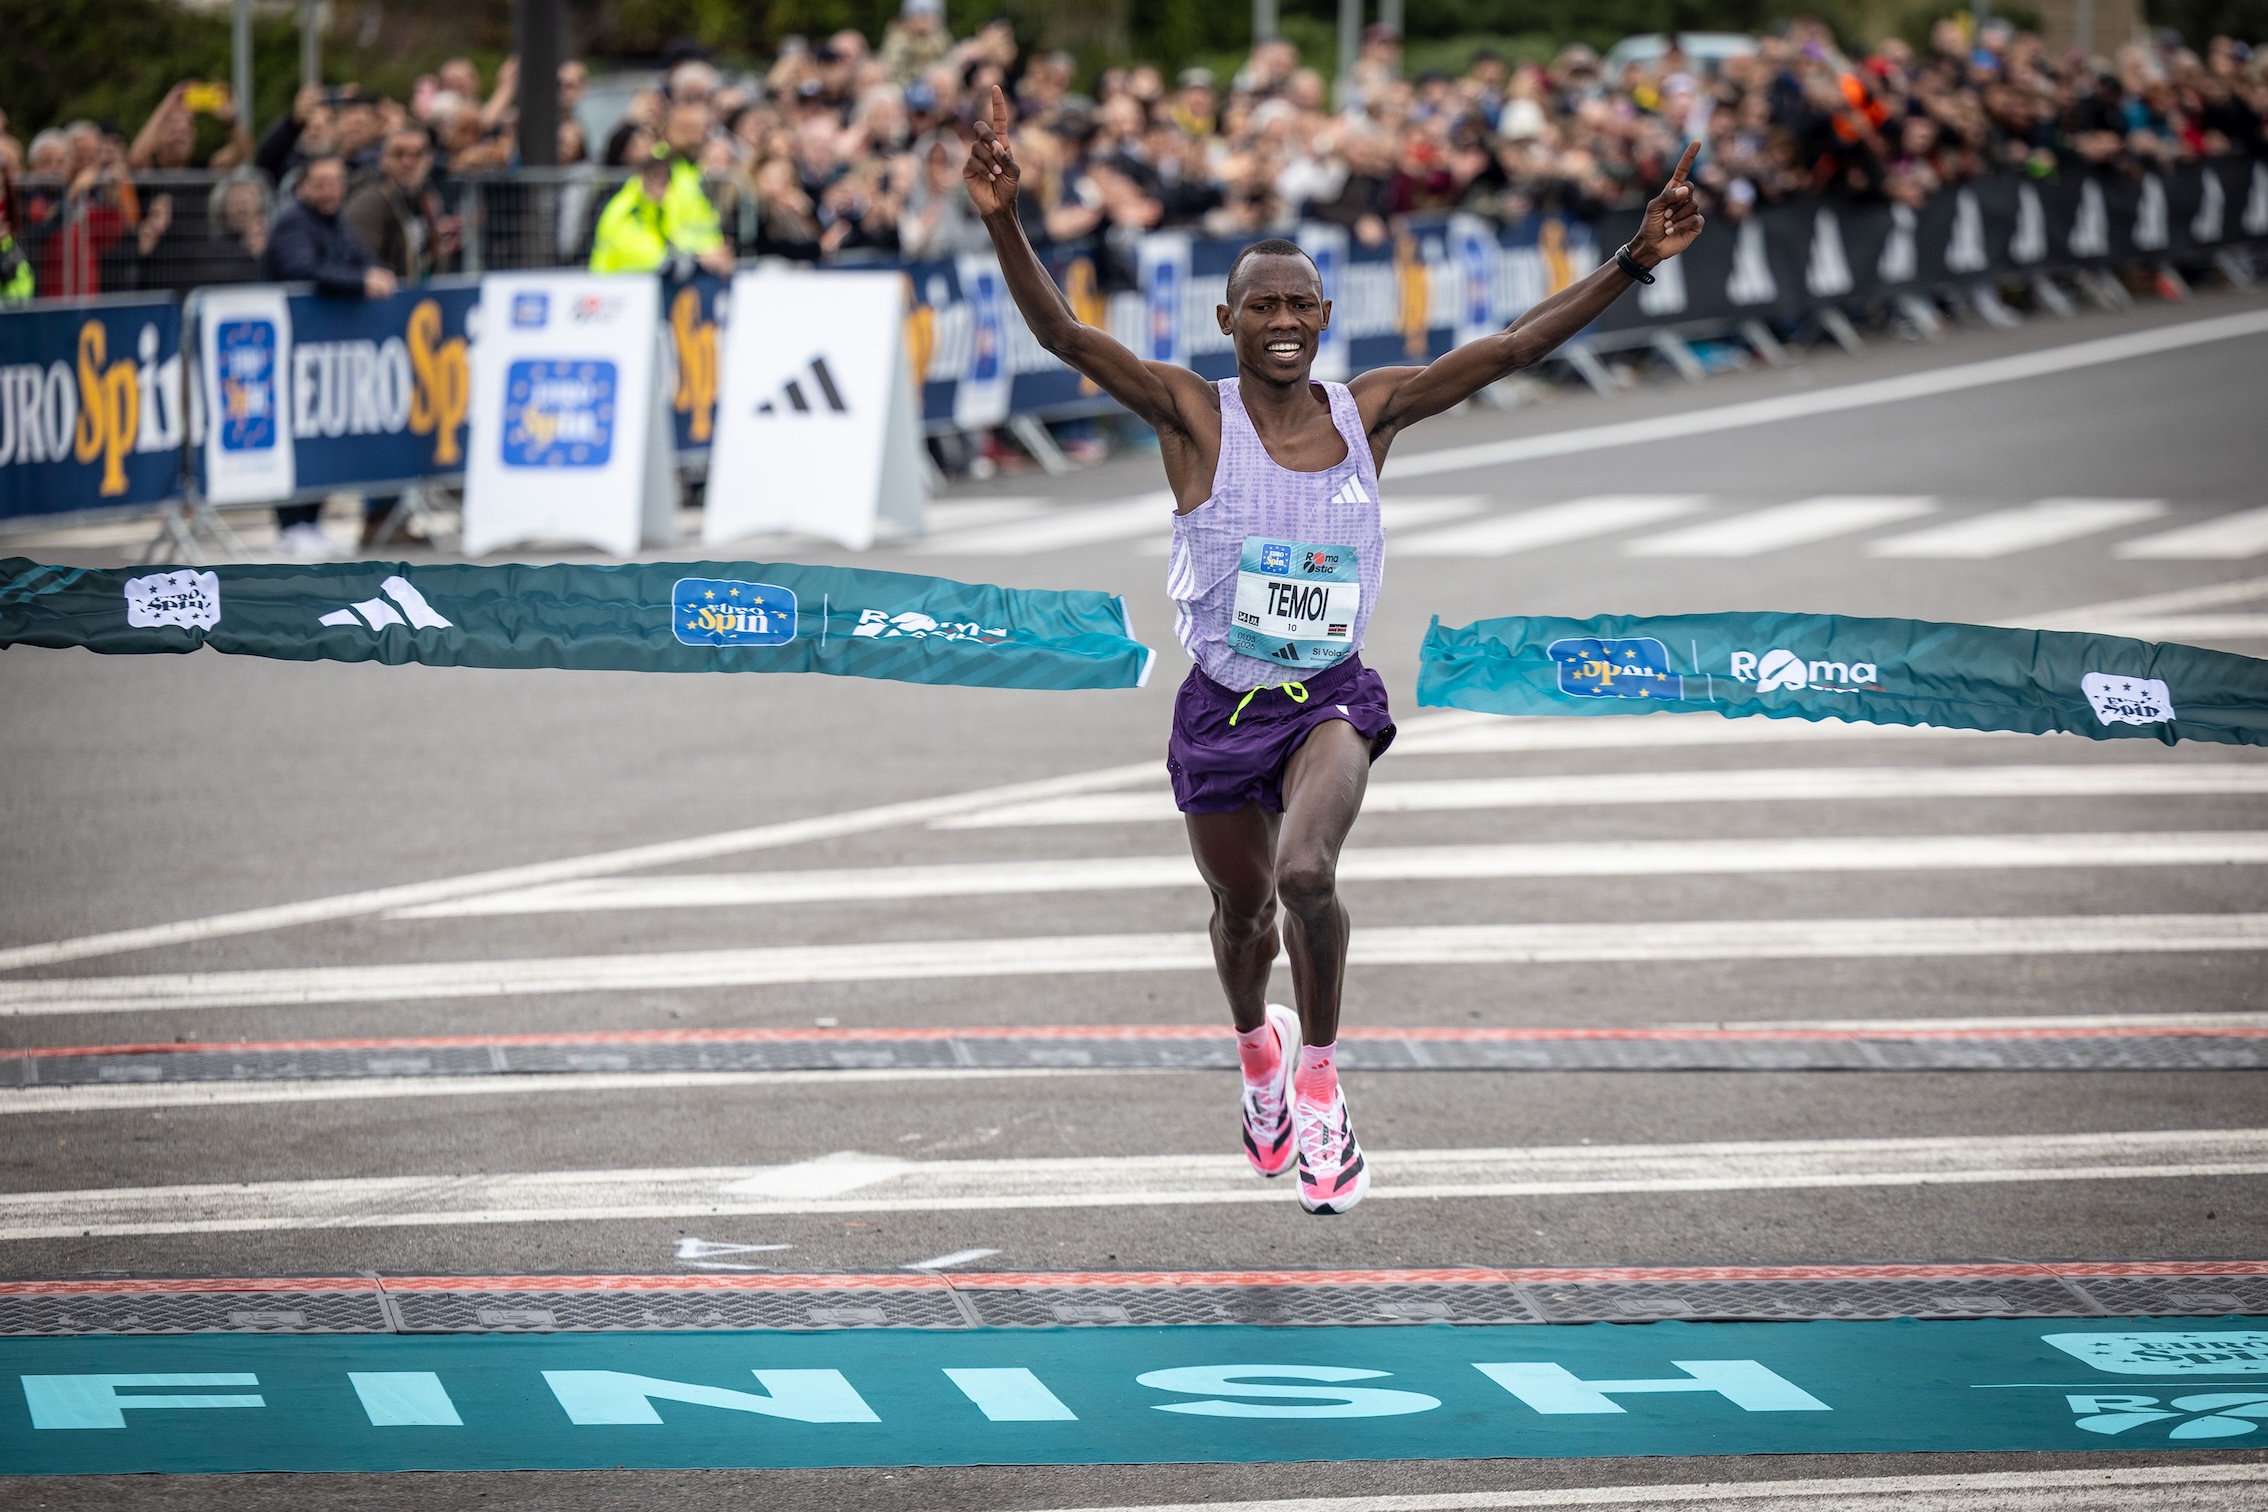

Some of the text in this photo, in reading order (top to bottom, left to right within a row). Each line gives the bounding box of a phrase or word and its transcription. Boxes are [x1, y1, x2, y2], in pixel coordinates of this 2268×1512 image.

[293, 298, 476, 467] EUROSp
[1265, 555, 1285, 568] Spin
[1267, 581, 1330, 621] TEMOI
[698, 607, 769, 637] Spin
[1287, 623, 1297, 632] 10
[1236, 640, 1256, 651] 2026
[1312, 647, 1342, 658] Si Vola
[20, 1361, 1833, 1430] FINISH
